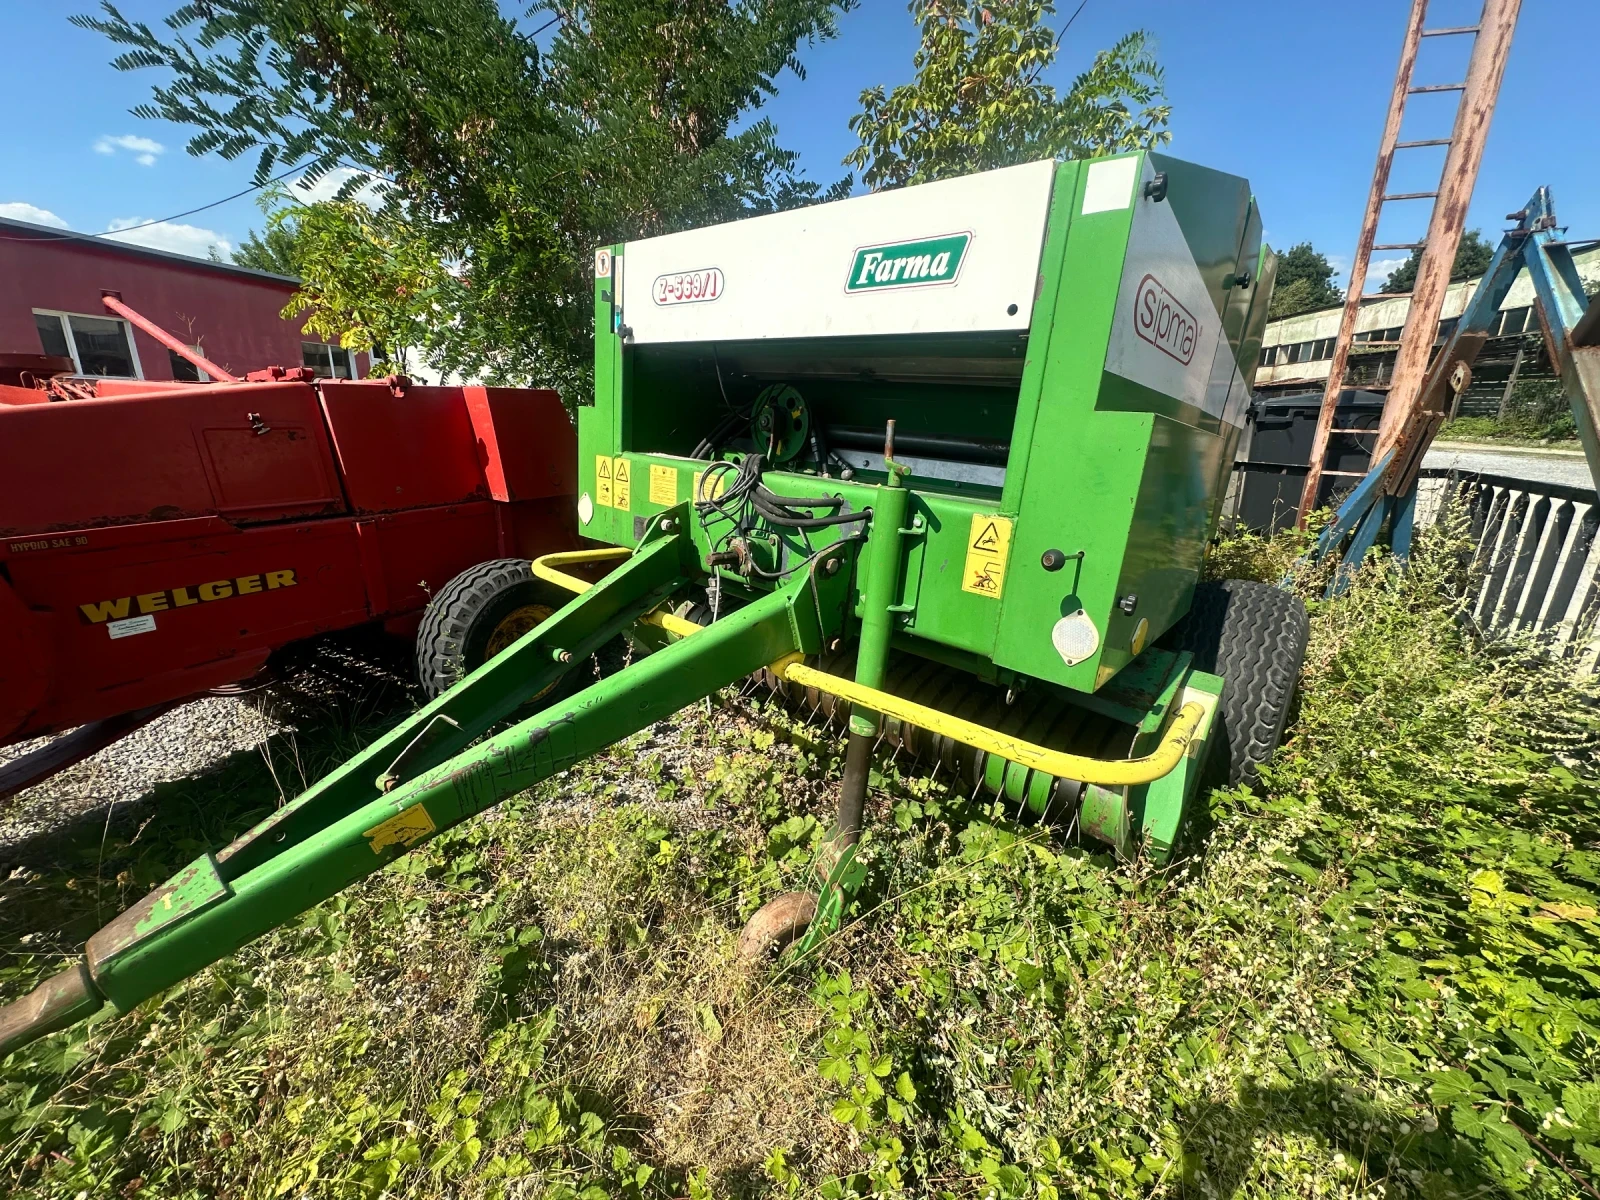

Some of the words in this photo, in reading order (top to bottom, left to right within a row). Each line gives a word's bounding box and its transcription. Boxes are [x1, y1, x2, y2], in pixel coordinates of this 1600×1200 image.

[856, 251, 951, 285] Farma
[659, 271, 717, 302] Z-569/1
[10, 540, 49, 553] HYPOID
[52, 538, 72, 548] SAE
[75, 536, 88, 545] 90
[80, 569, 298, 623] WELGER
